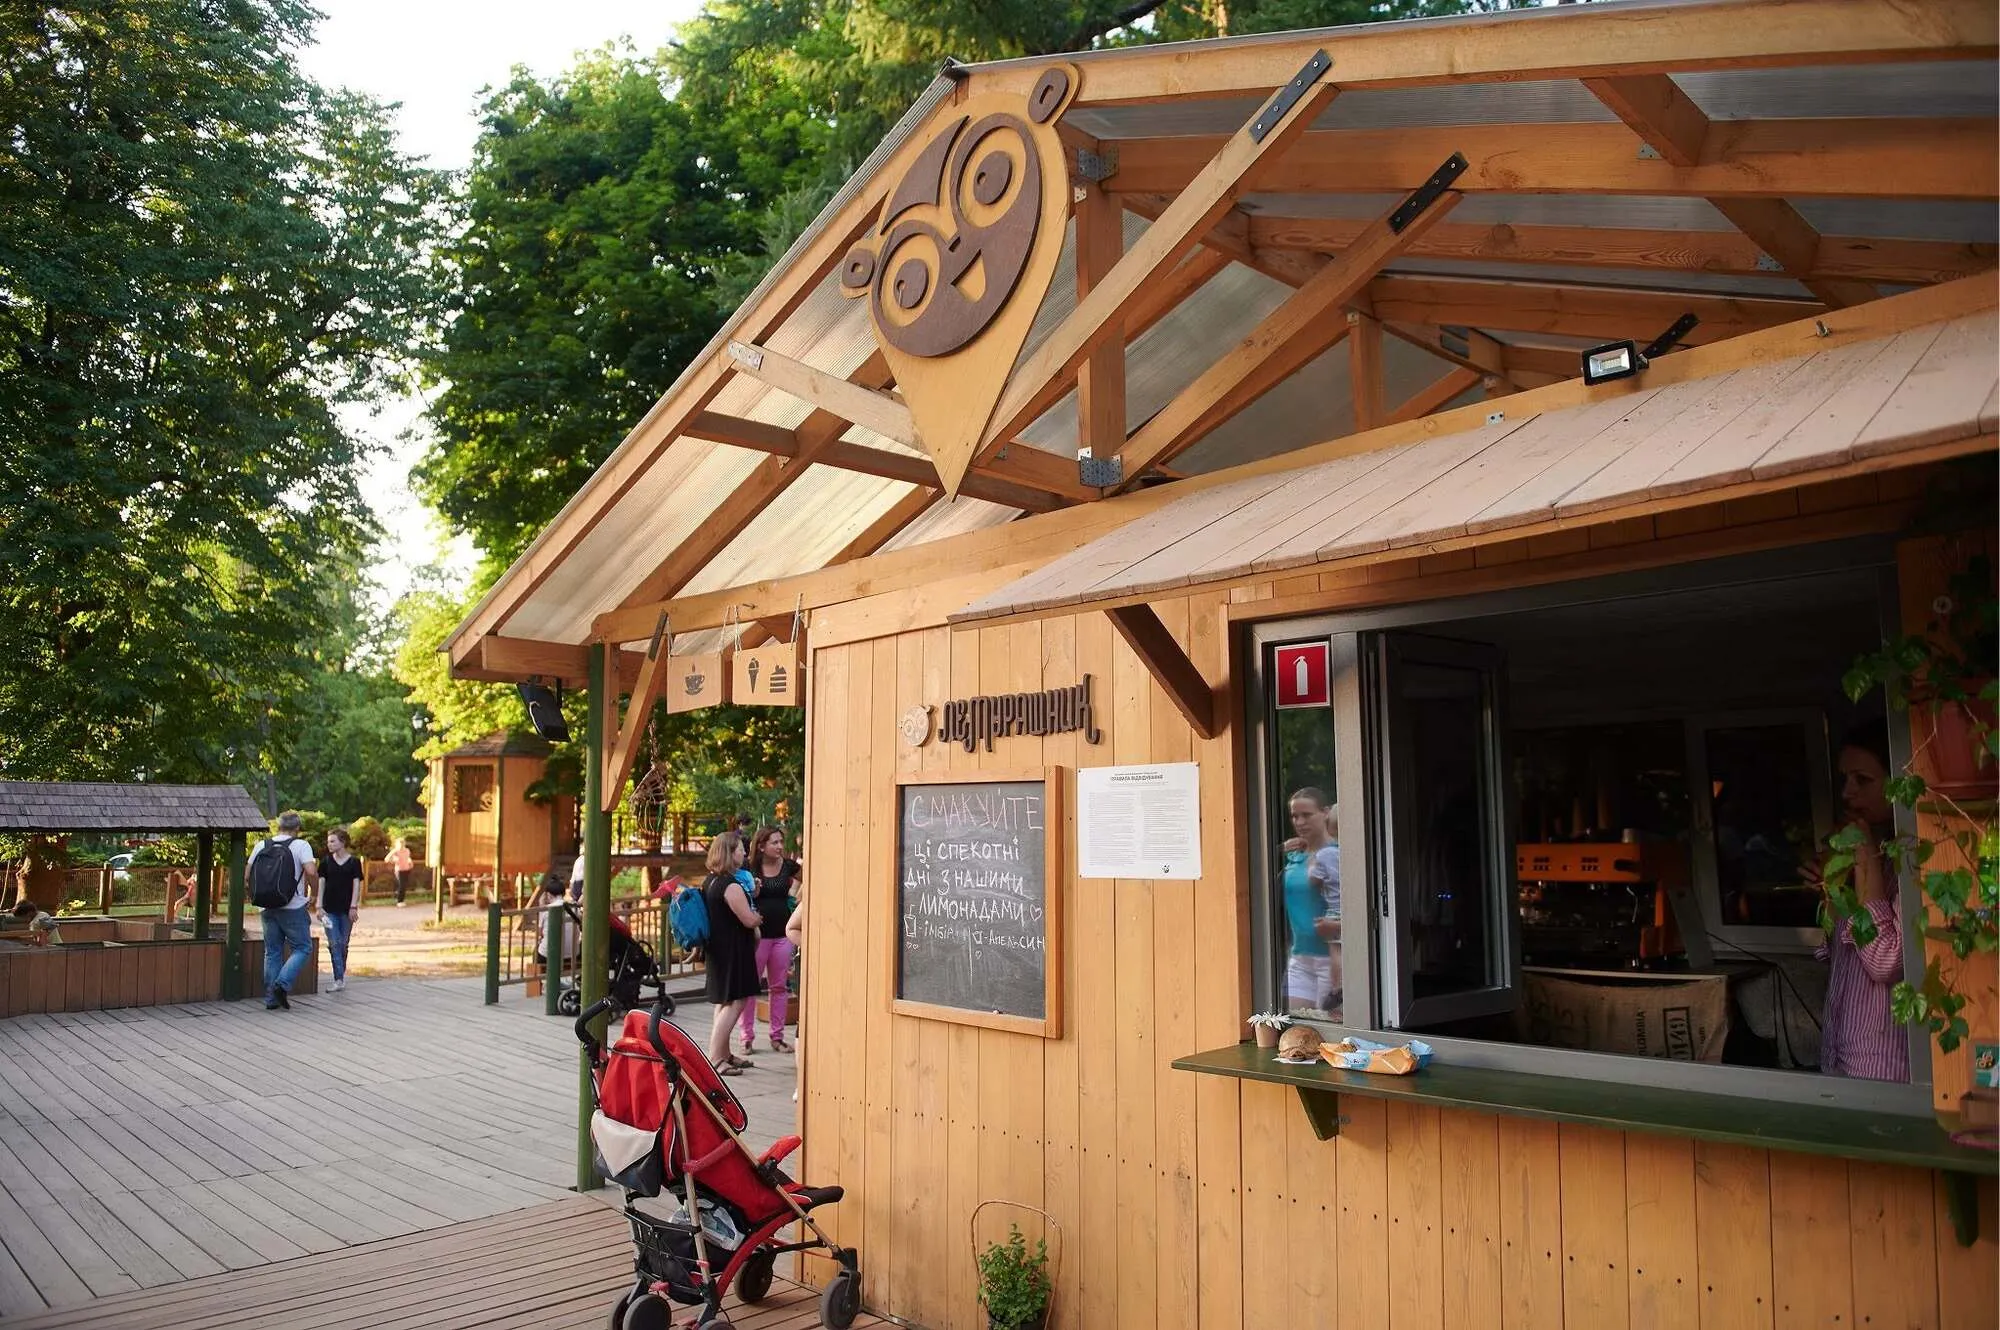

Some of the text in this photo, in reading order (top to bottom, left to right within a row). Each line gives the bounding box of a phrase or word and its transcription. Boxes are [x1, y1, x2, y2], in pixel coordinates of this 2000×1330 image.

[911, 788, 1043, 831] СМАКУЙТЕ
[937, 869, 950, 896] З
[954, 870, 1024, 895] НАШИМИ
[918, 891, 1025, 928] ЛИМОНАДАМИ
